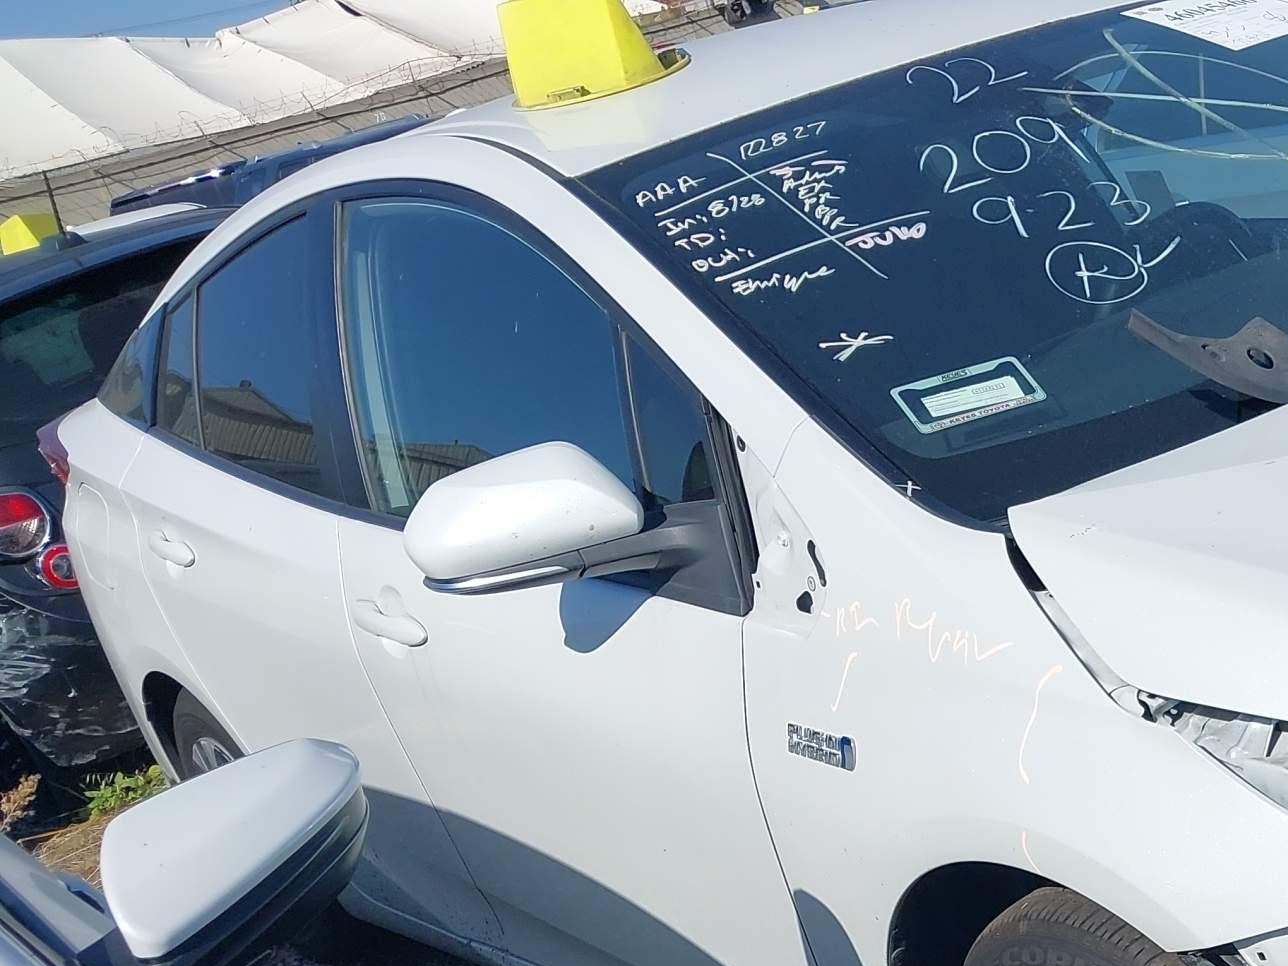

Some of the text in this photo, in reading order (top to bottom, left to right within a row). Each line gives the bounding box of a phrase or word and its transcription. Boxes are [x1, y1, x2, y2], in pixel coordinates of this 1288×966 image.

[907, 57, 1028, 103] 22
[919, 116, 1091, 194] 209
[635, 176, 707, 208] AAA
